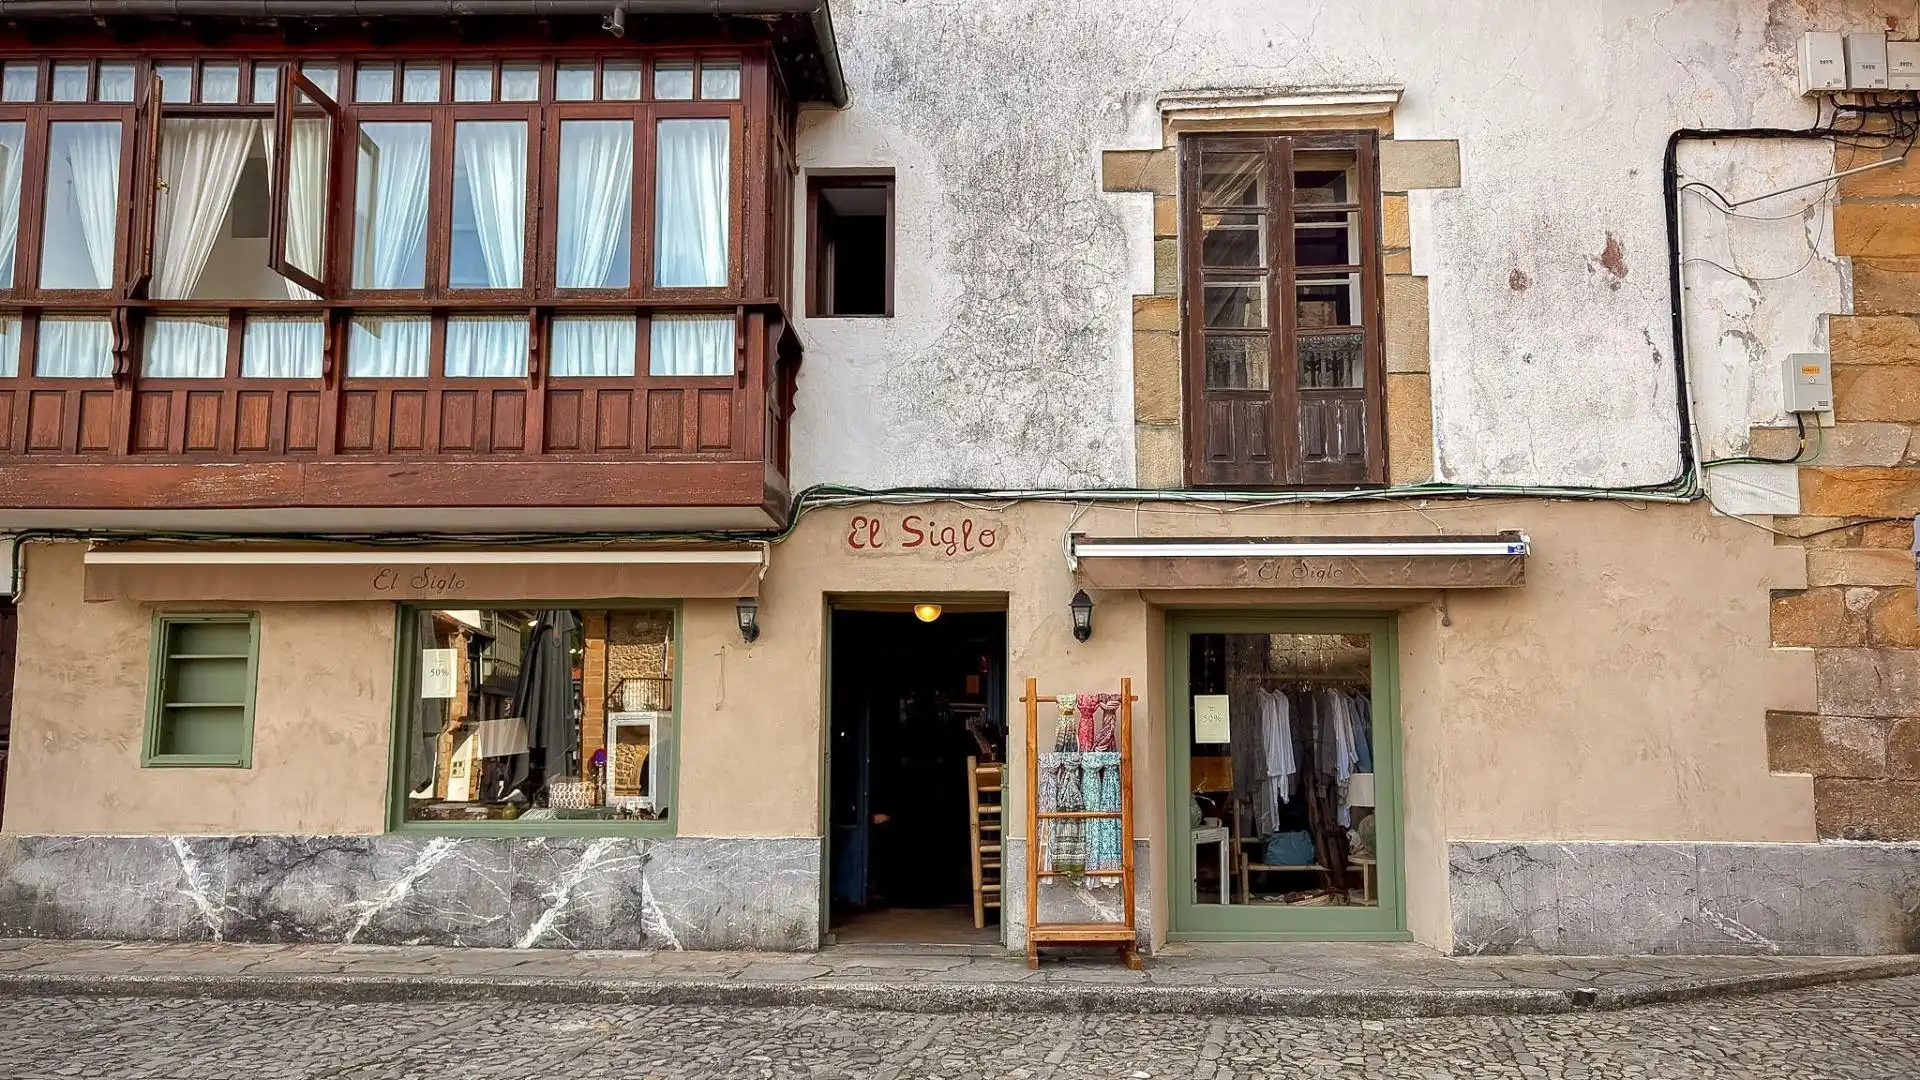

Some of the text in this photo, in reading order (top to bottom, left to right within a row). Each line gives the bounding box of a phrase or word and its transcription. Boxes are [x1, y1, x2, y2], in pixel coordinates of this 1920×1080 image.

[847, 515, 997, 557] El Siglo
[373, 566, 466, 595] El Siglo
[1258, 560, 1343, 584] El Siglo
[430, 667, 451, 678] 50%
